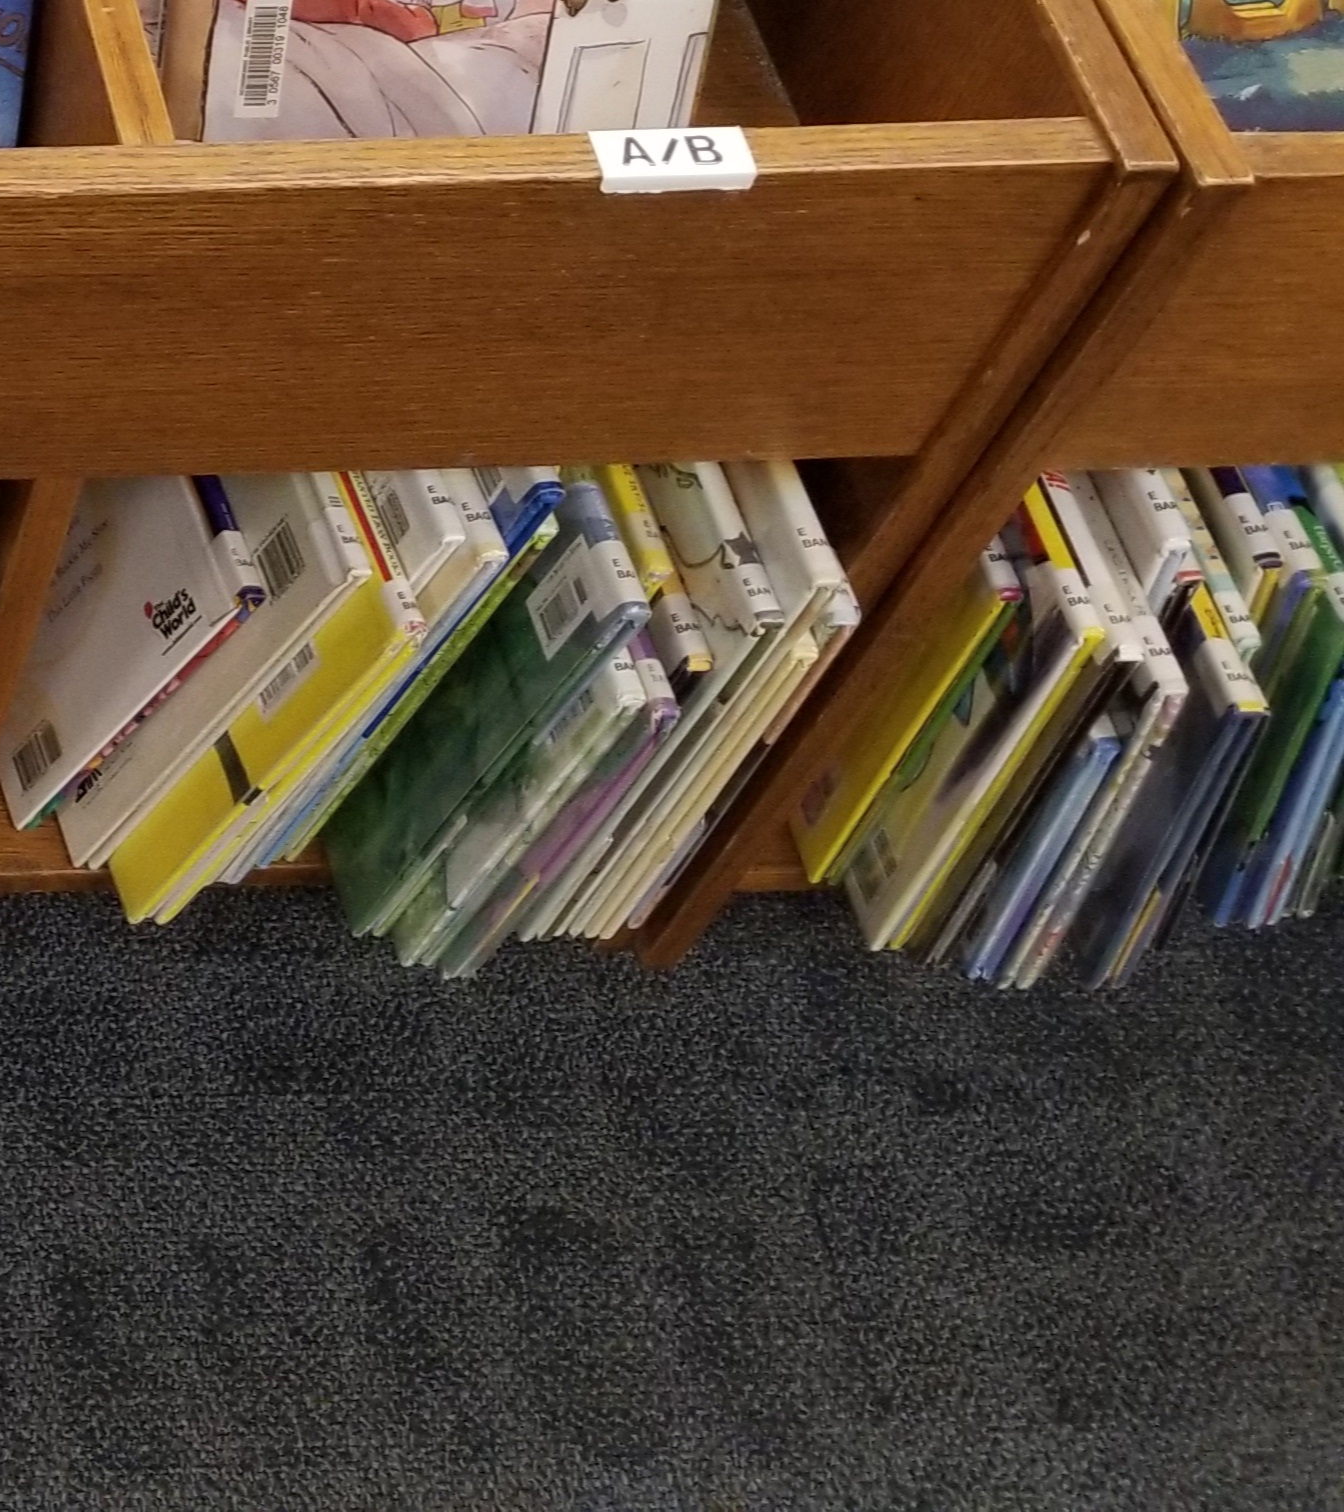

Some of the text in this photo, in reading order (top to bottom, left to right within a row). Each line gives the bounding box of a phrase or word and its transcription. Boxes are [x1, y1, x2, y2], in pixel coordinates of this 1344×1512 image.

[621, 134, 723, 168] A/B
[802, 538, 827, 548] BAN
[747, 587, 771, 597] BAN
[152, 588, 189, 629] Child's
[160, 596, 196, 639] World
[676, 623, 699, 633] BAN
